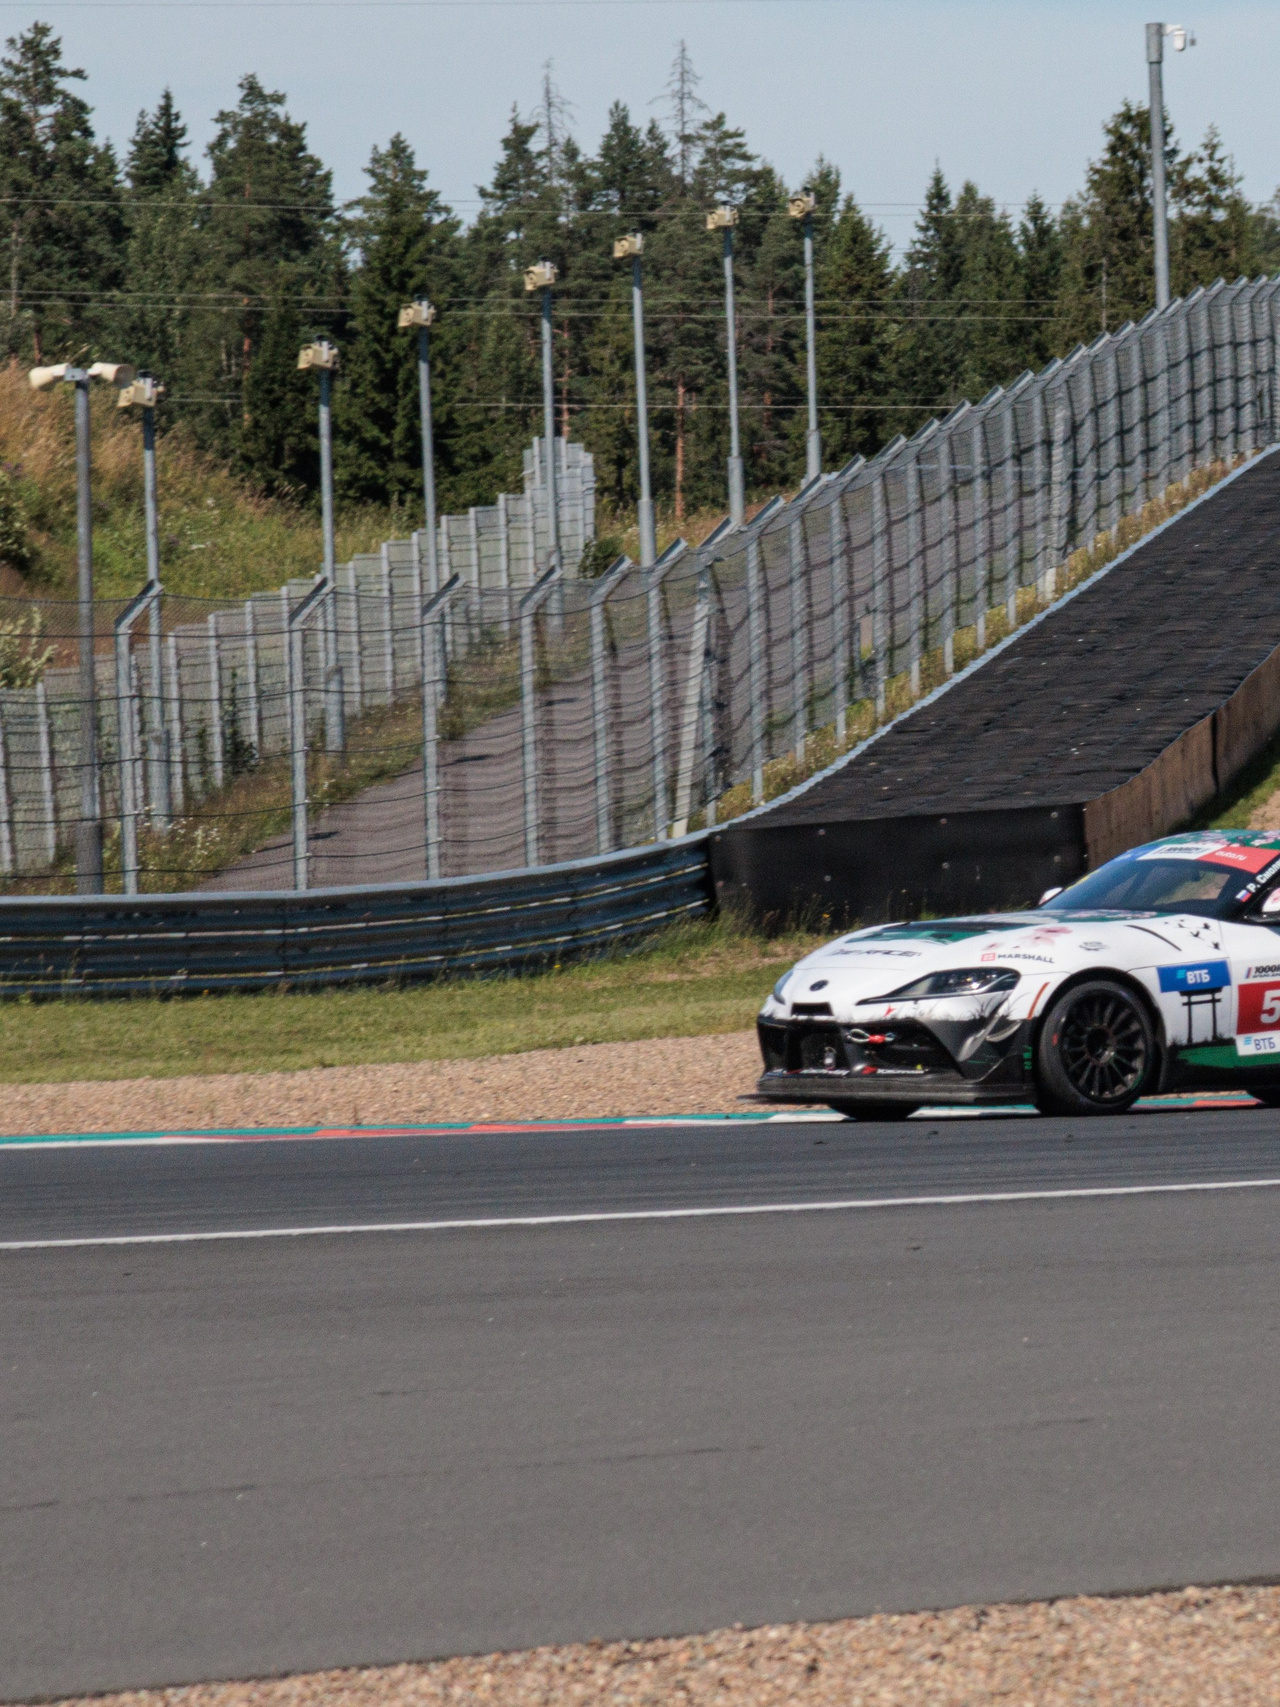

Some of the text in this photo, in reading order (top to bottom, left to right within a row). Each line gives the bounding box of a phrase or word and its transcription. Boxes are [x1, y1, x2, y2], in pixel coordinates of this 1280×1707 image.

[997, 953, 1055, 964] MARSHALL
[1186, 969, 1211, 984] ВТБ
[1254, 1036, 1276, 1051] ВТБ
